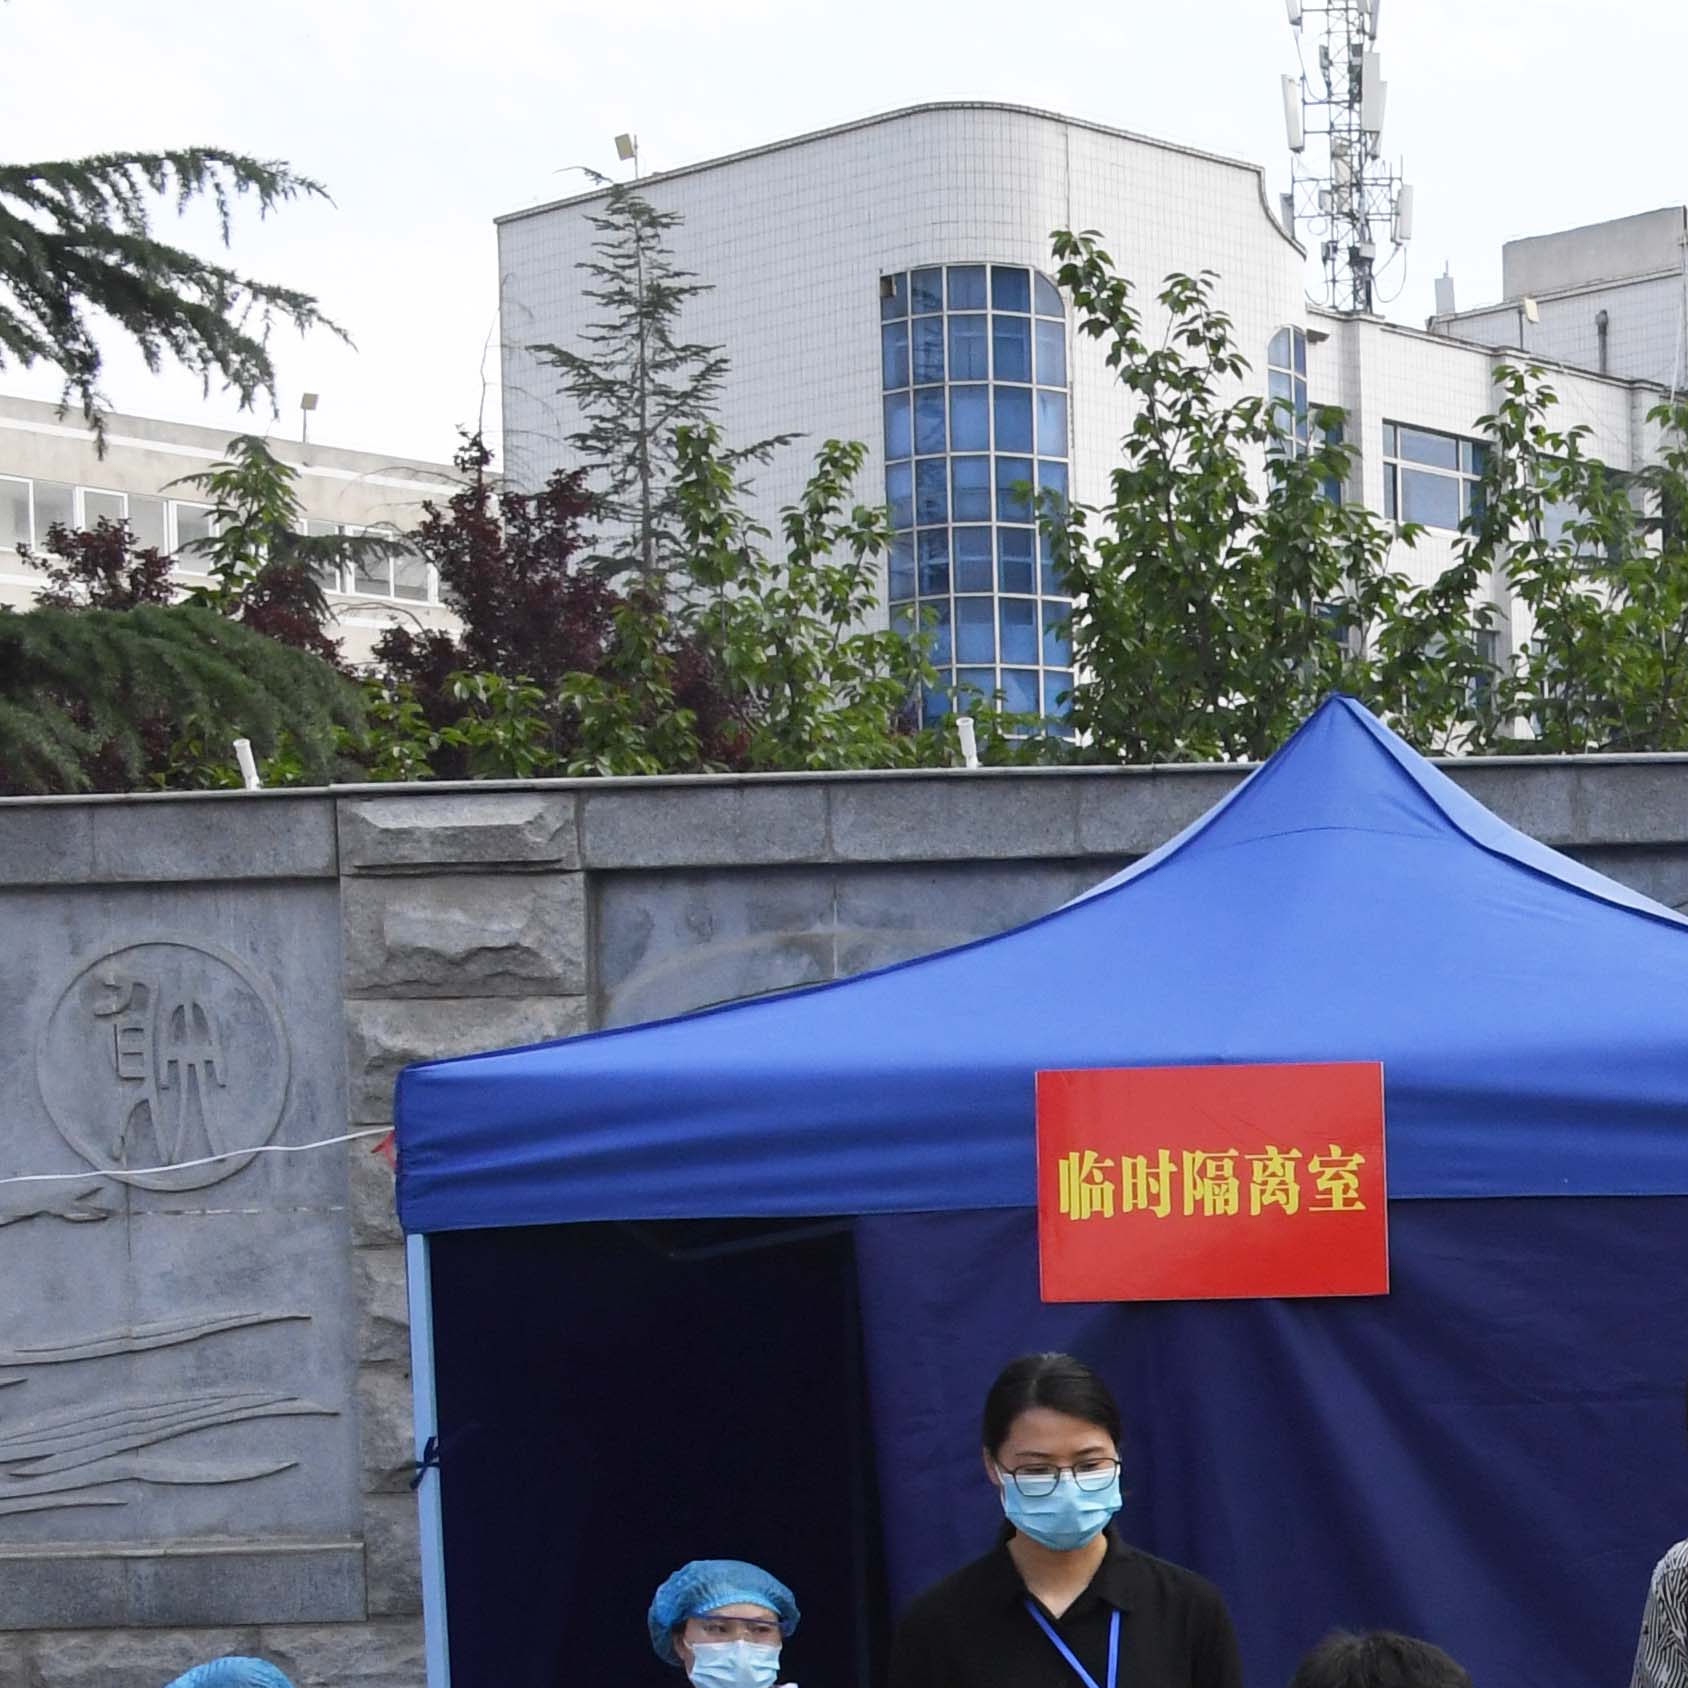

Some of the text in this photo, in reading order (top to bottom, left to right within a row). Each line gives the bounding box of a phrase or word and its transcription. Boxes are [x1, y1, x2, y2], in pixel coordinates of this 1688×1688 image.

[1057, 1144, 1367, 1221] 临时隔离室
